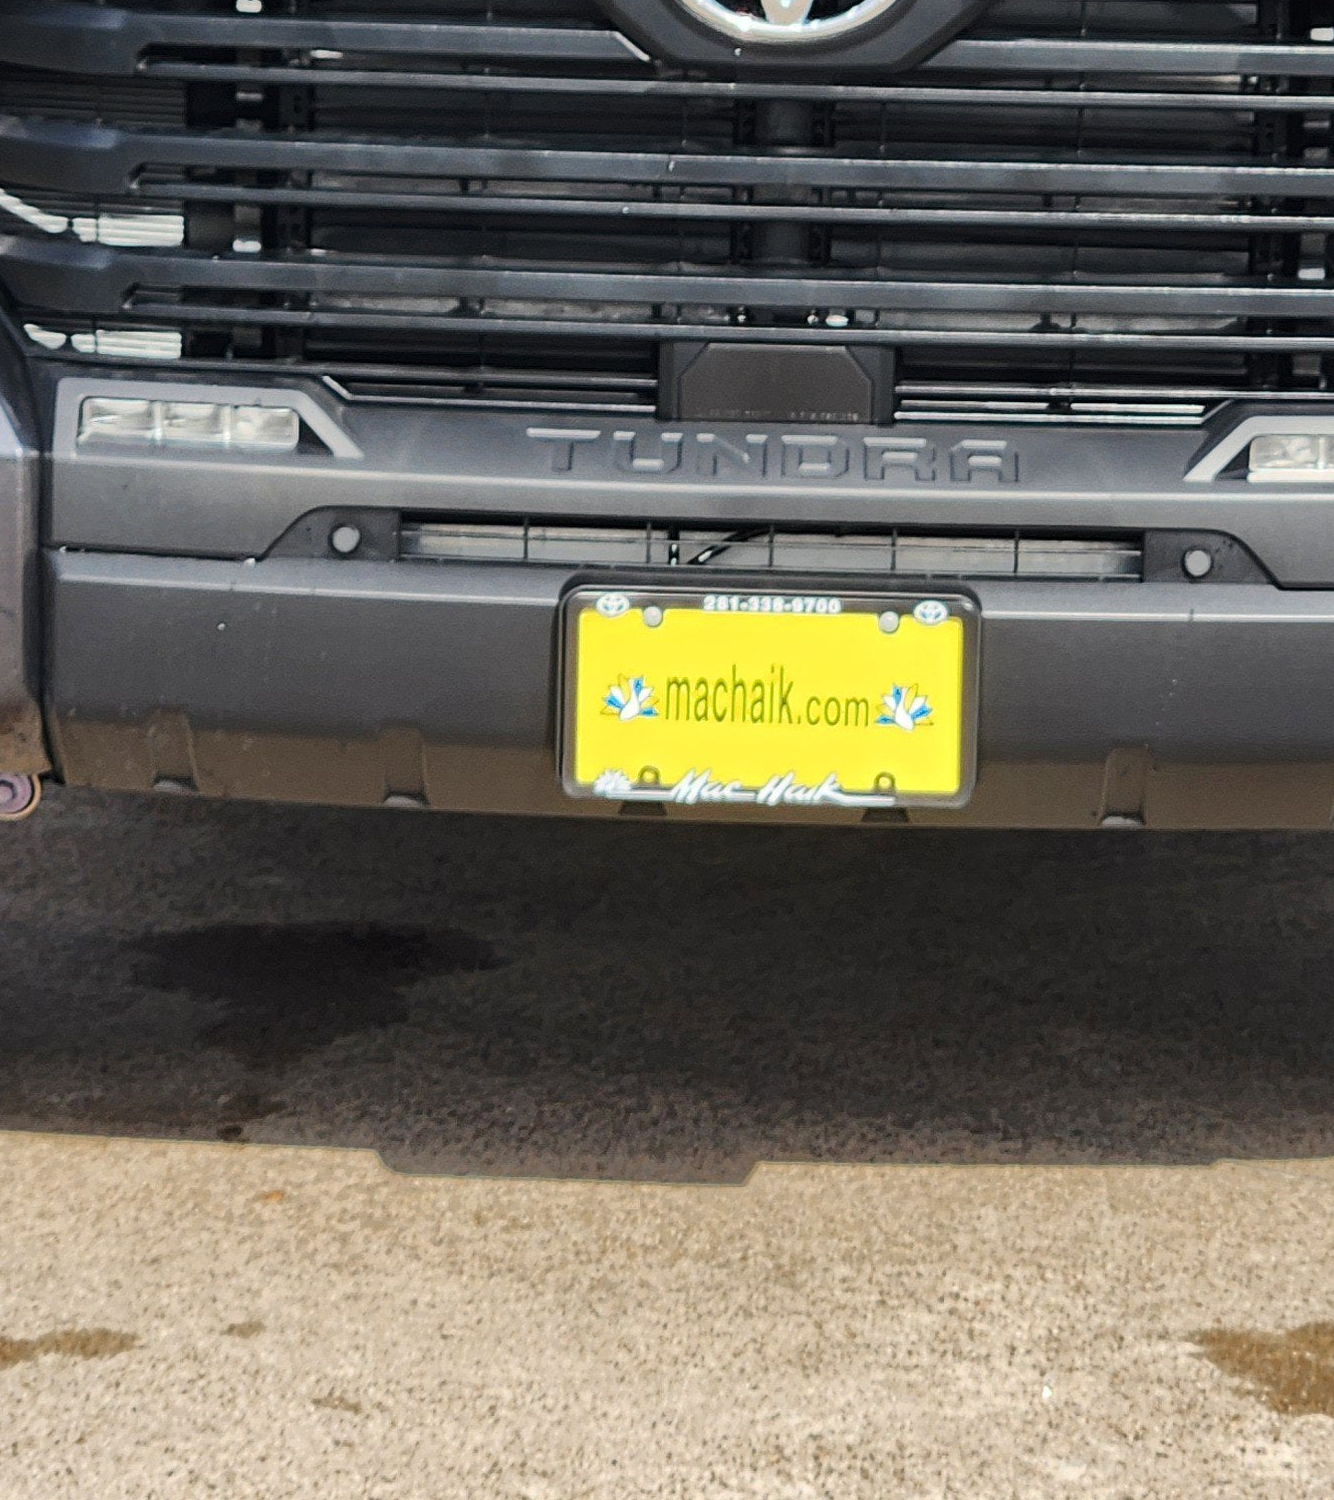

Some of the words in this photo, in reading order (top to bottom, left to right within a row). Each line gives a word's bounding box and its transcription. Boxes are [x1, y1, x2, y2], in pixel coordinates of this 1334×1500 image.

[527, 426, 1020, 482] TUNDRA
[665, 664, 869, 728] machaik.com
[670, 768, 744, 805] Mac
